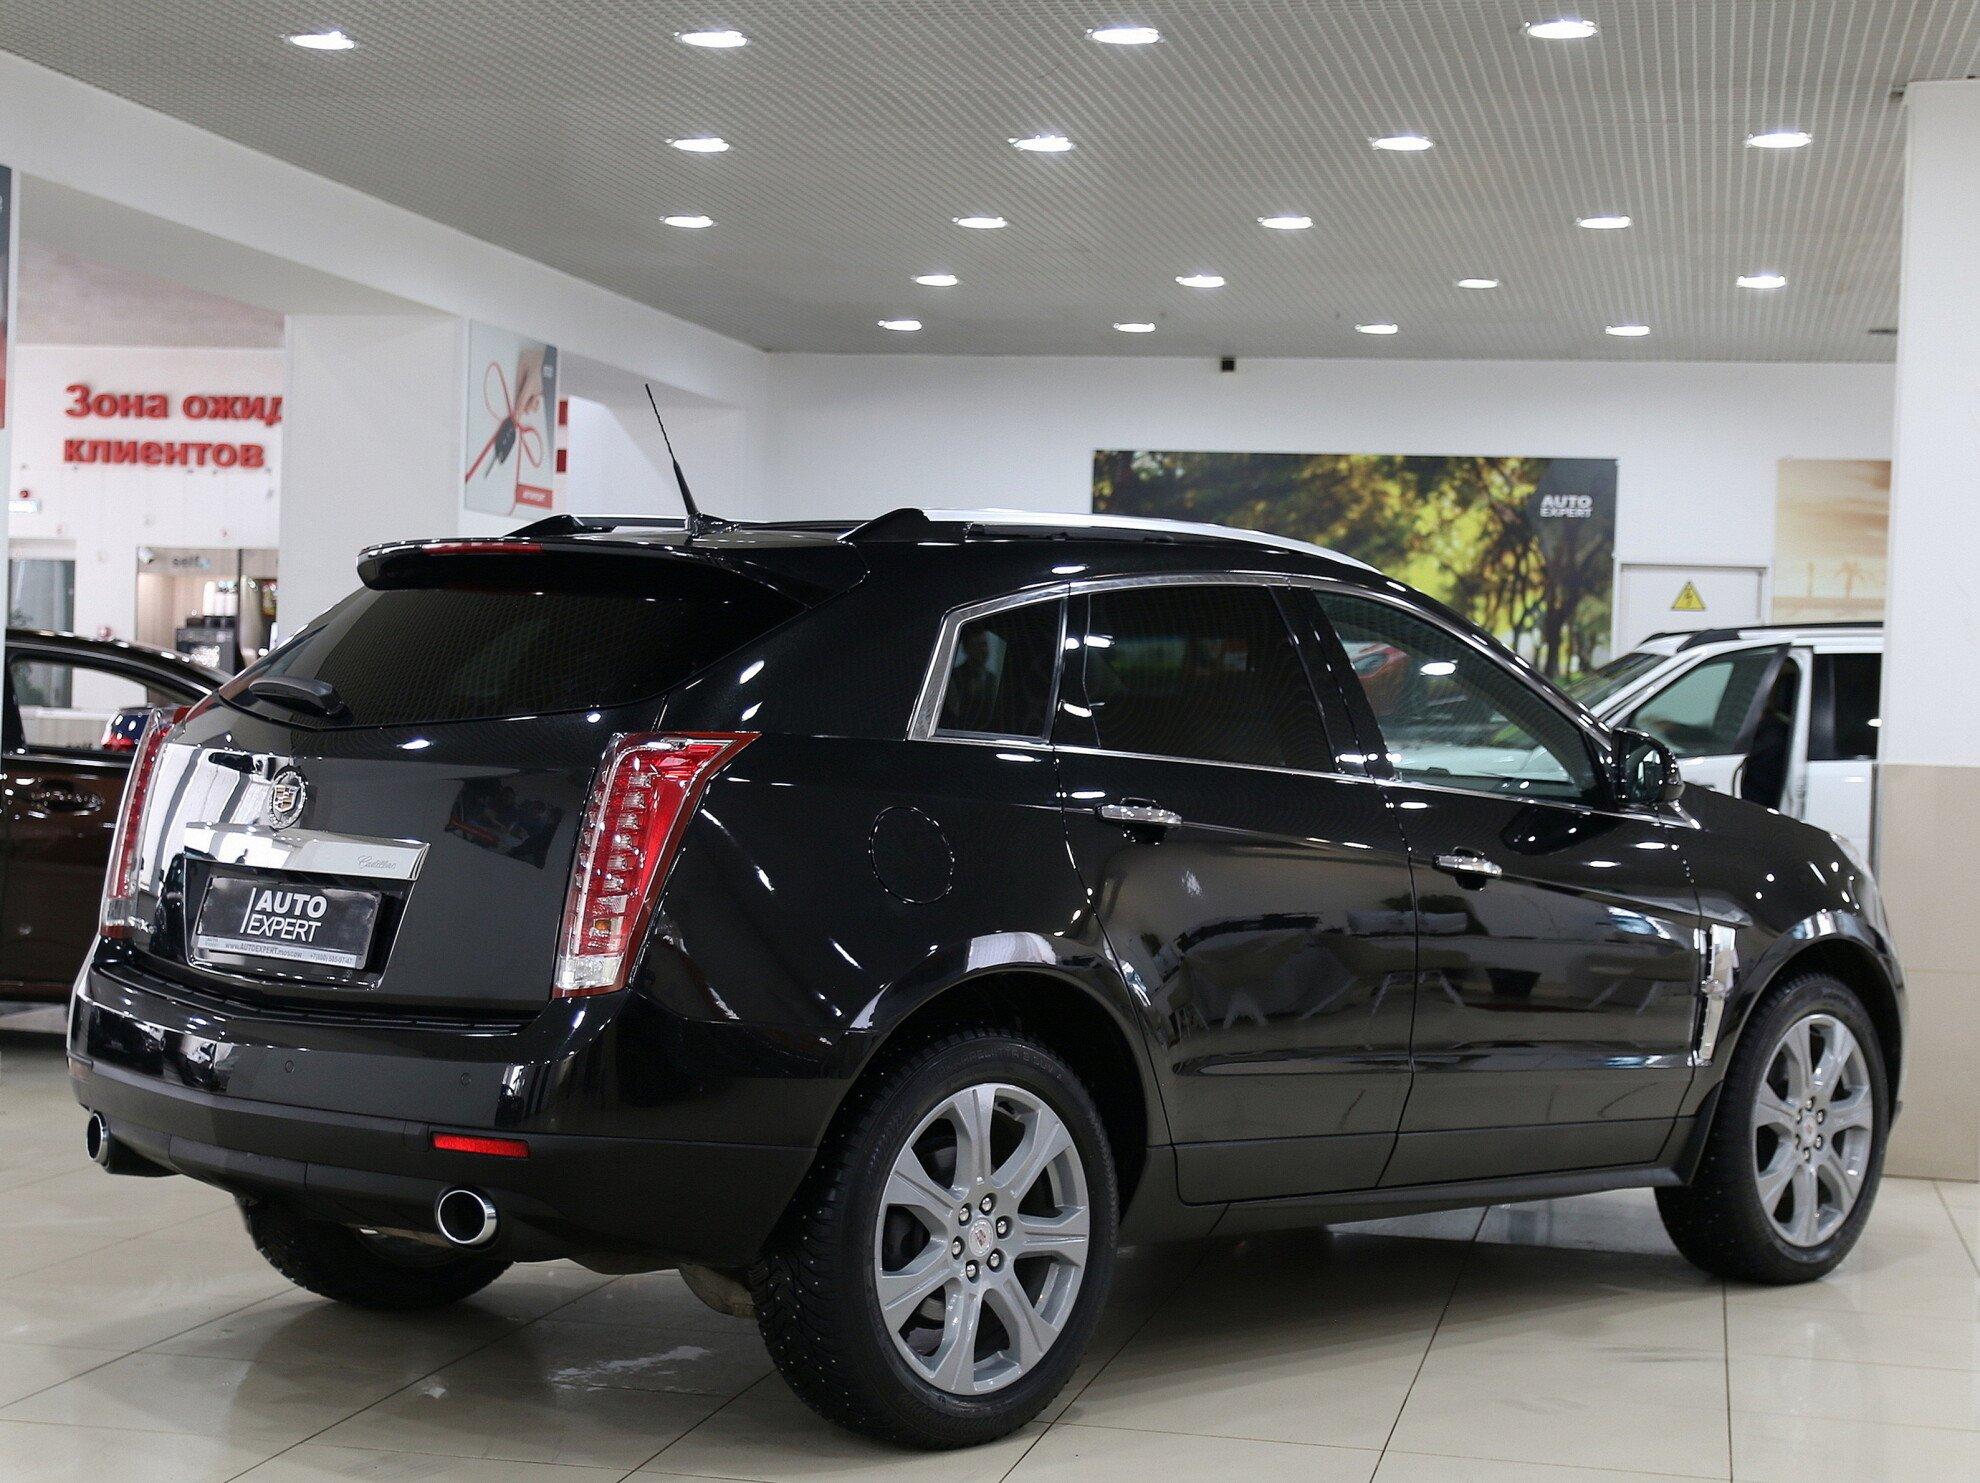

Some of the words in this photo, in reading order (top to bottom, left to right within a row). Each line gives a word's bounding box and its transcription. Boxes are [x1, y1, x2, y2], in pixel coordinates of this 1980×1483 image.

[64, 384, 169, 419] Зона
[64, 438, 266, 469] клиентов
[1540, 508, 1593, 518] EXPERT
[1541, 494, 1594, 509] AUTO
[254, 889, 328, 919] AUTO
[246, 913, 322, 943] EXPERT
